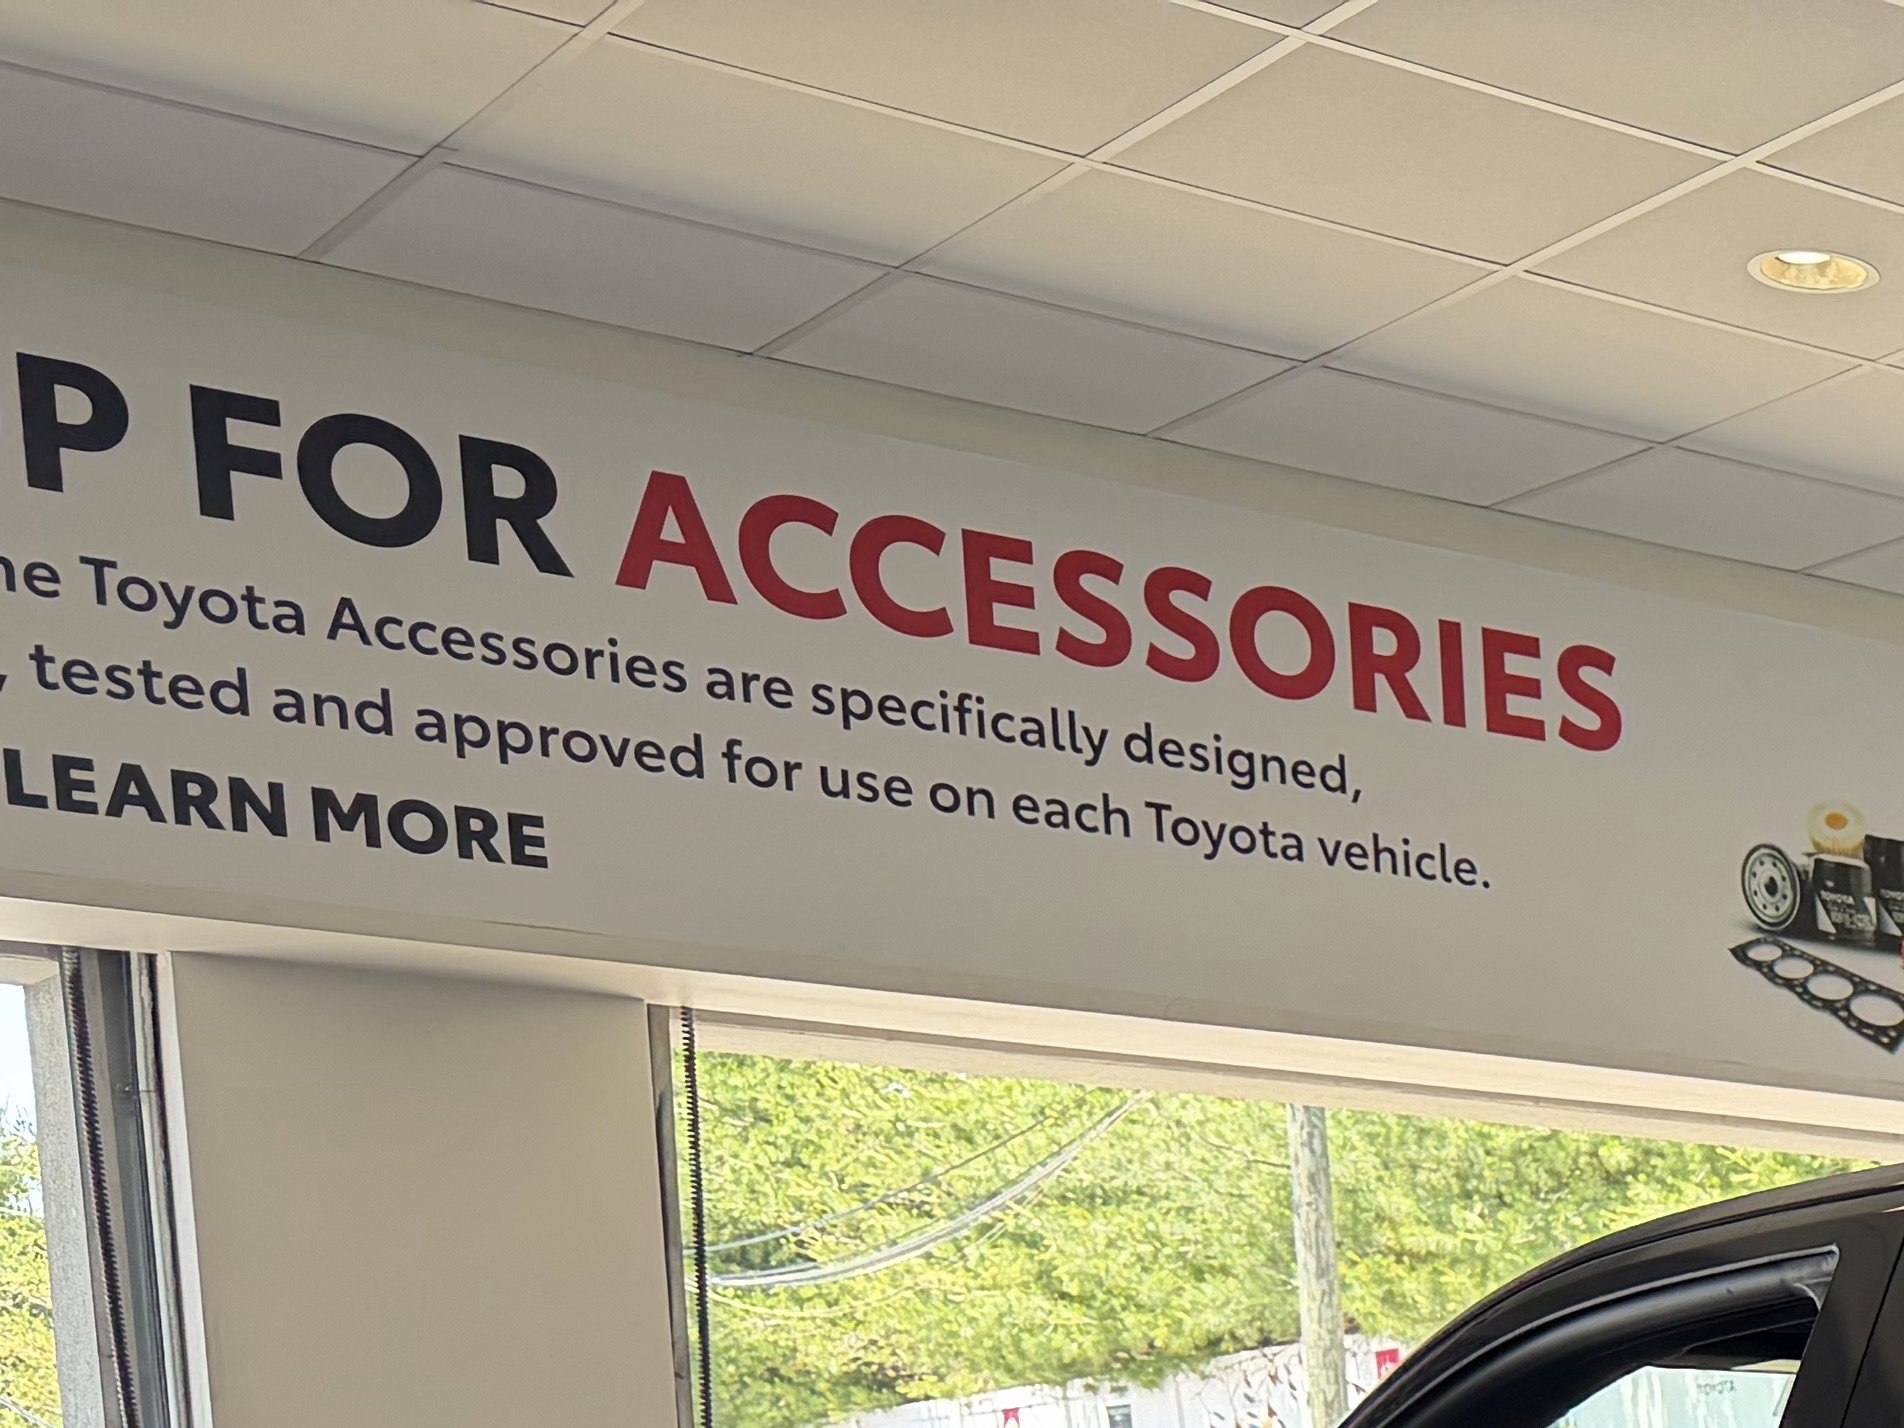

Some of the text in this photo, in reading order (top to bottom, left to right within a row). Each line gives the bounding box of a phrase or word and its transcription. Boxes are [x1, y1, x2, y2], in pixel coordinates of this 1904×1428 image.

[15, 351, 1623, 752] P FOR ACCESSORIES
[29, 645, 1493, 891] tested and approved for use on each Toyota vehicle.
[79, 556, 306, 636] Toyota
[327, 597, 688, 694] Accessories
[705, 668, 794, 709] are
[811, 684, 1109, 767] specifically
[1123, 722, 1362, 803] designed,
[3, 748, 549, 868] LEARN MORE
